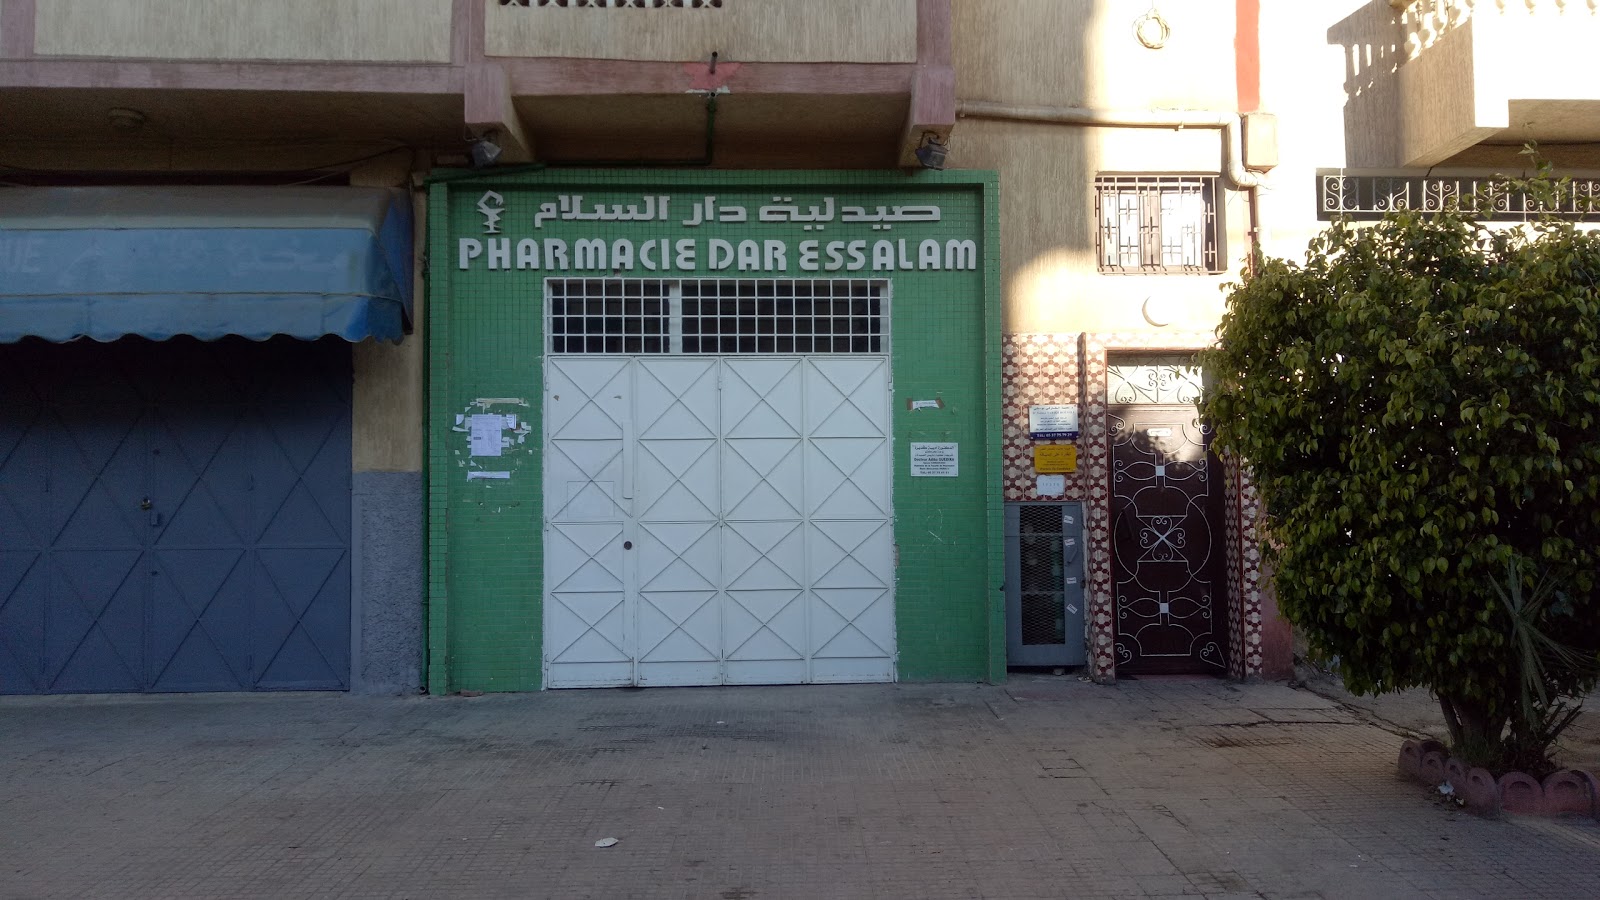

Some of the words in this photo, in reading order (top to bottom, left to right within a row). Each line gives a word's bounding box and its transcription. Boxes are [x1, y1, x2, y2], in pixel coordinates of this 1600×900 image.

[534, 195, 671, 229] السلام
[682, 196, 747, 226] دار
[759, 196, 941, 231] صيدلية
[459, 237, 696, 271] PHARMACIE
[708, 238, 787, 271] DAR
[799, 238, 977, 271] ESSALAM
